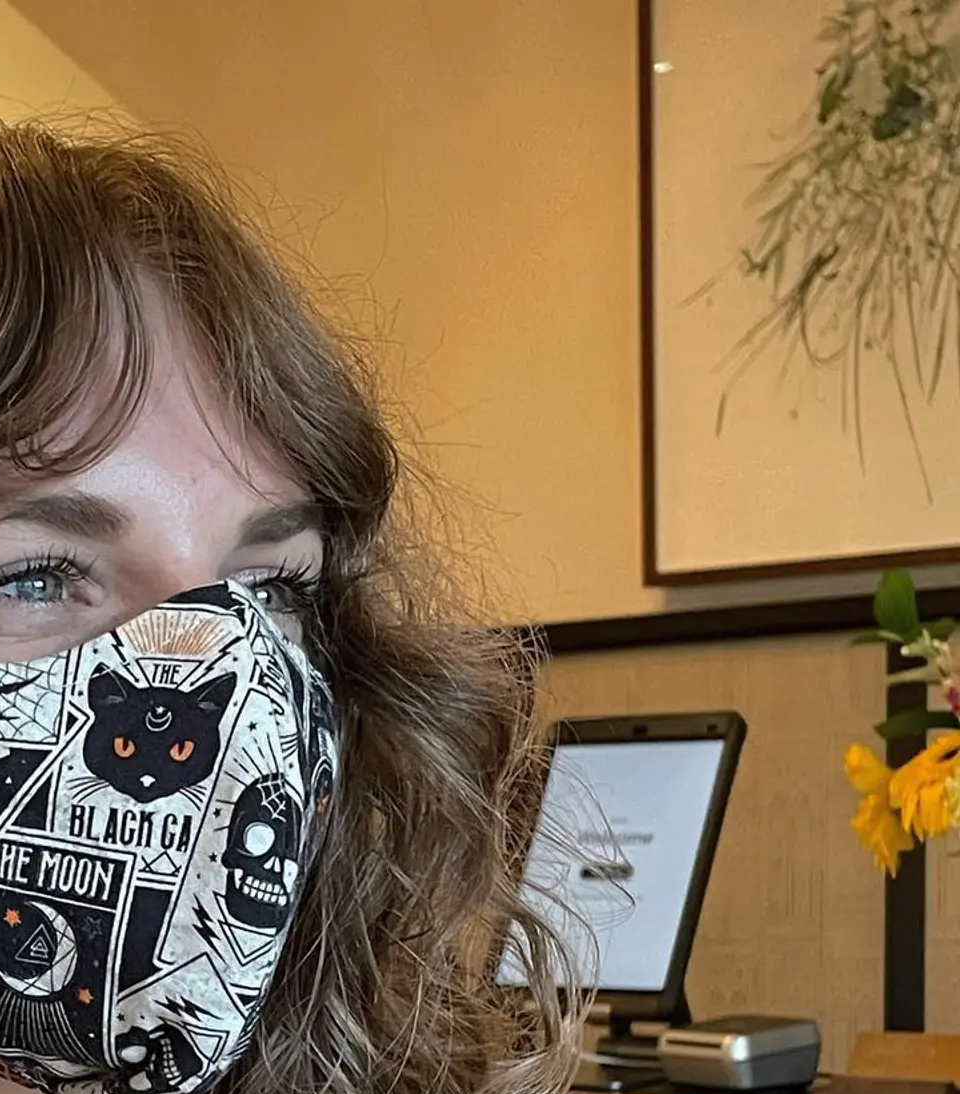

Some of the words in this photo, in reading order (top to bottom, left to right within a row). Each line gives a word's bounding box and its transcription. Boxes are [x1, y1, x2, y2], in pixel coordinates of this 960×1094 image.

[152, 663, 182, 685] THE
[69, 804, 155, 848] BLACK
[37, 850, 116, 900] MOON
